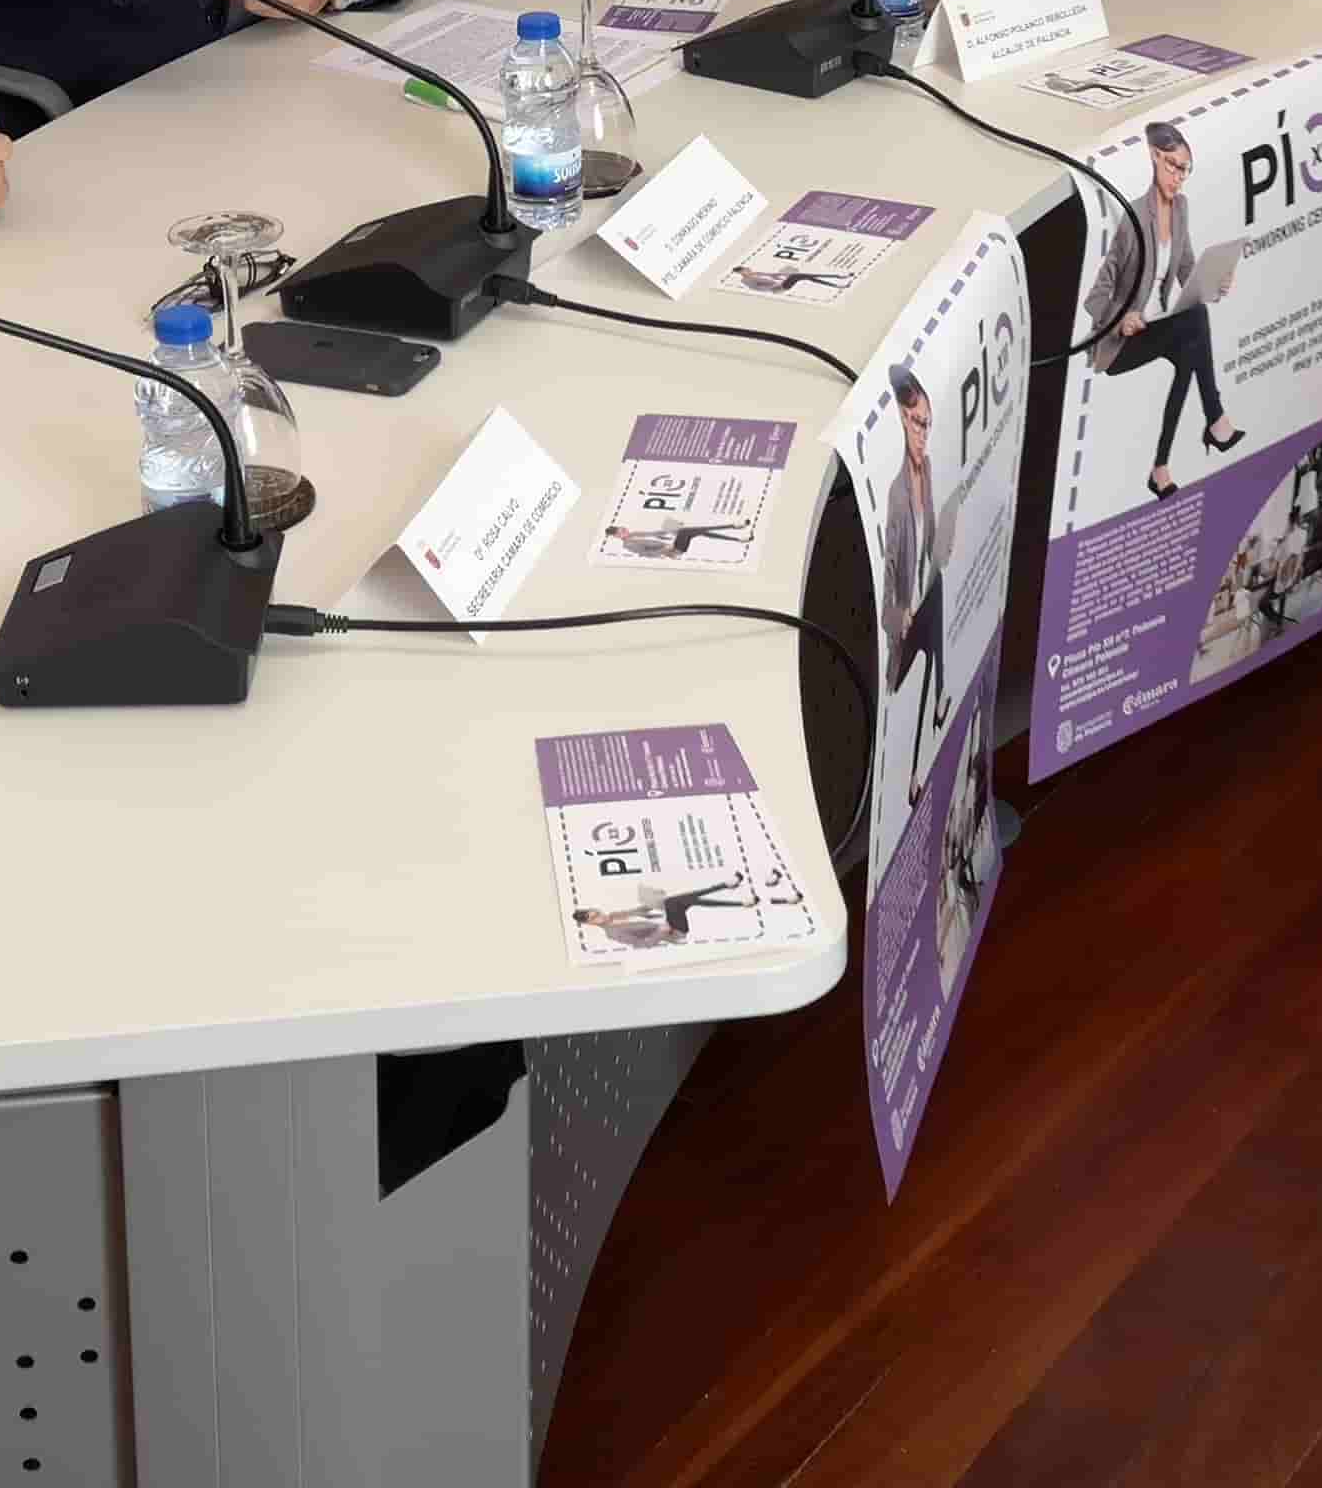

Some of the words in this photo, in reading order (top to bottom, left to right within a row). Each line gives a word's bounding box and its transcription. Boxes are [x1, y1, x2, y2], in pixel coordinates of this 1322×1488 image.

[465, 561, 506, 620] SECRETARIA
[528, 477, 563, 525] COMERCIO
[480, 520, 502, 550] ROSA
[495, 494, 520, 529] CALVO
